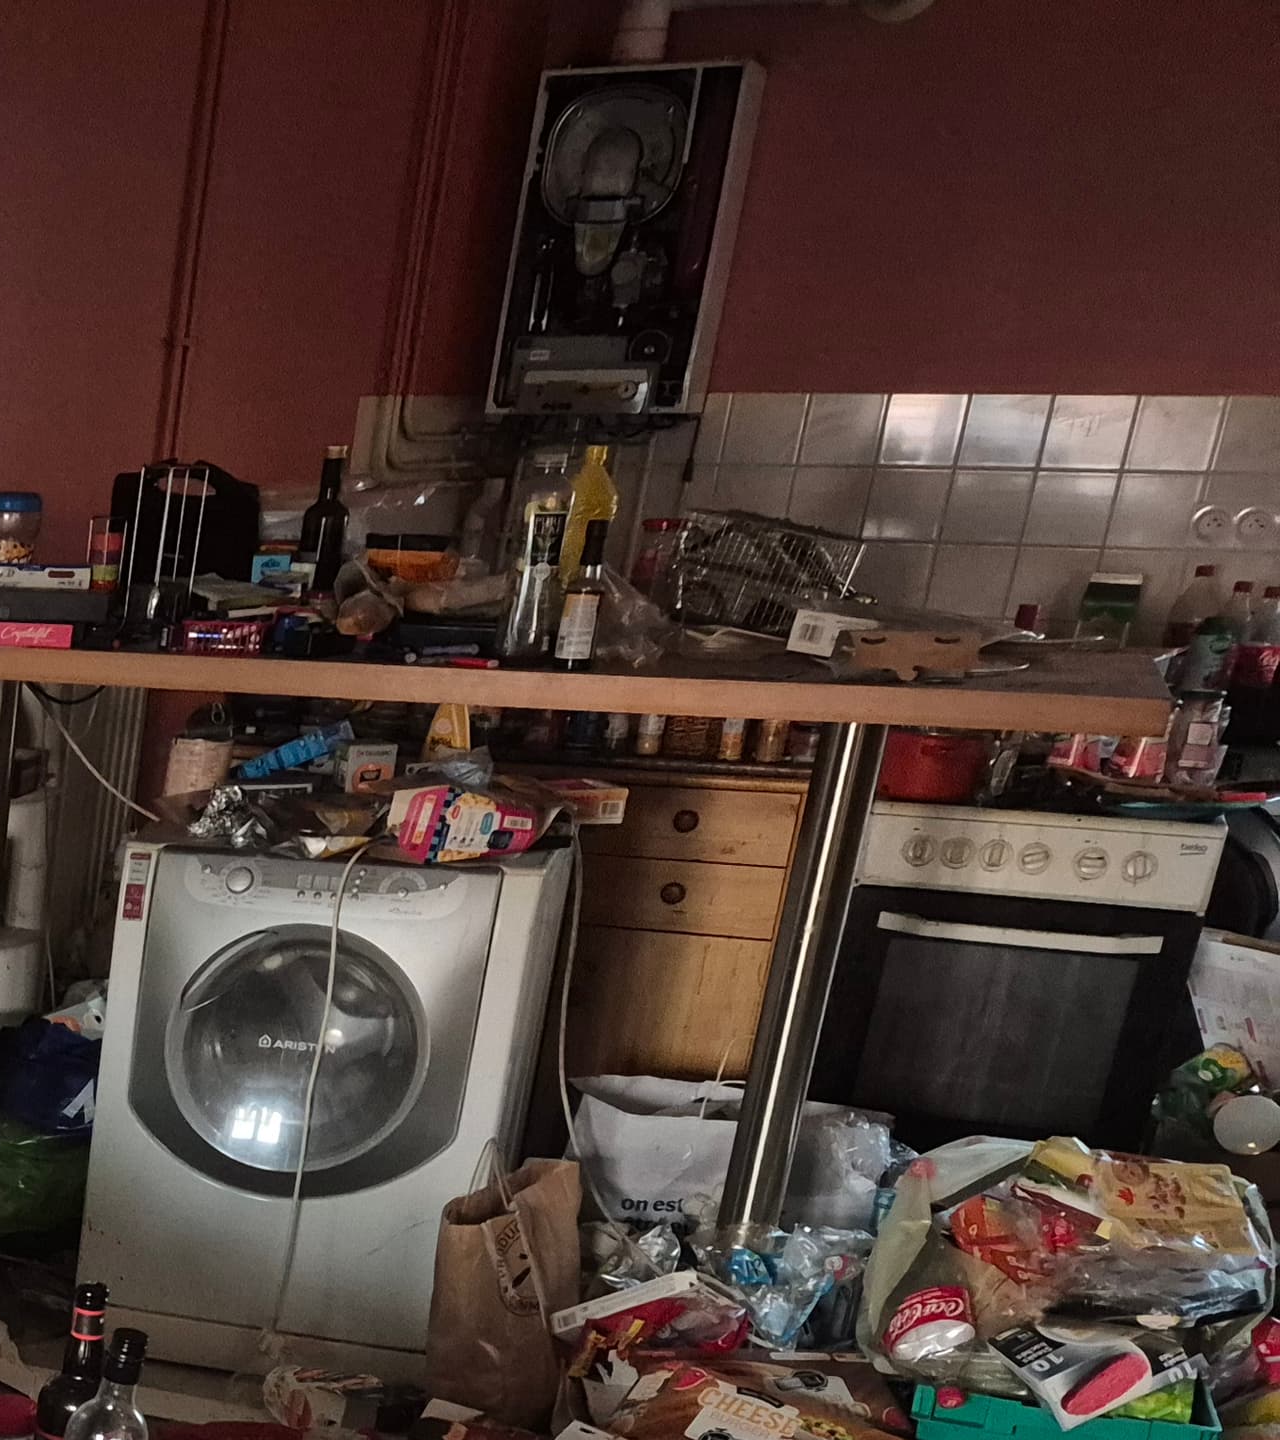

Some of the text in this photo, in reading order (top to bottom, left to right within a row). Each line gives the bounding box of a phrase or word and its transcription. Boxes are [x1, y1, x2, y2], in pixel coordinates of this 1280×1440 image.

[272, 1038, 336, 1055] ARISTN
[621, 1198, 647, 1211] on
[697, 1387, 801, 1437] CHEESE
